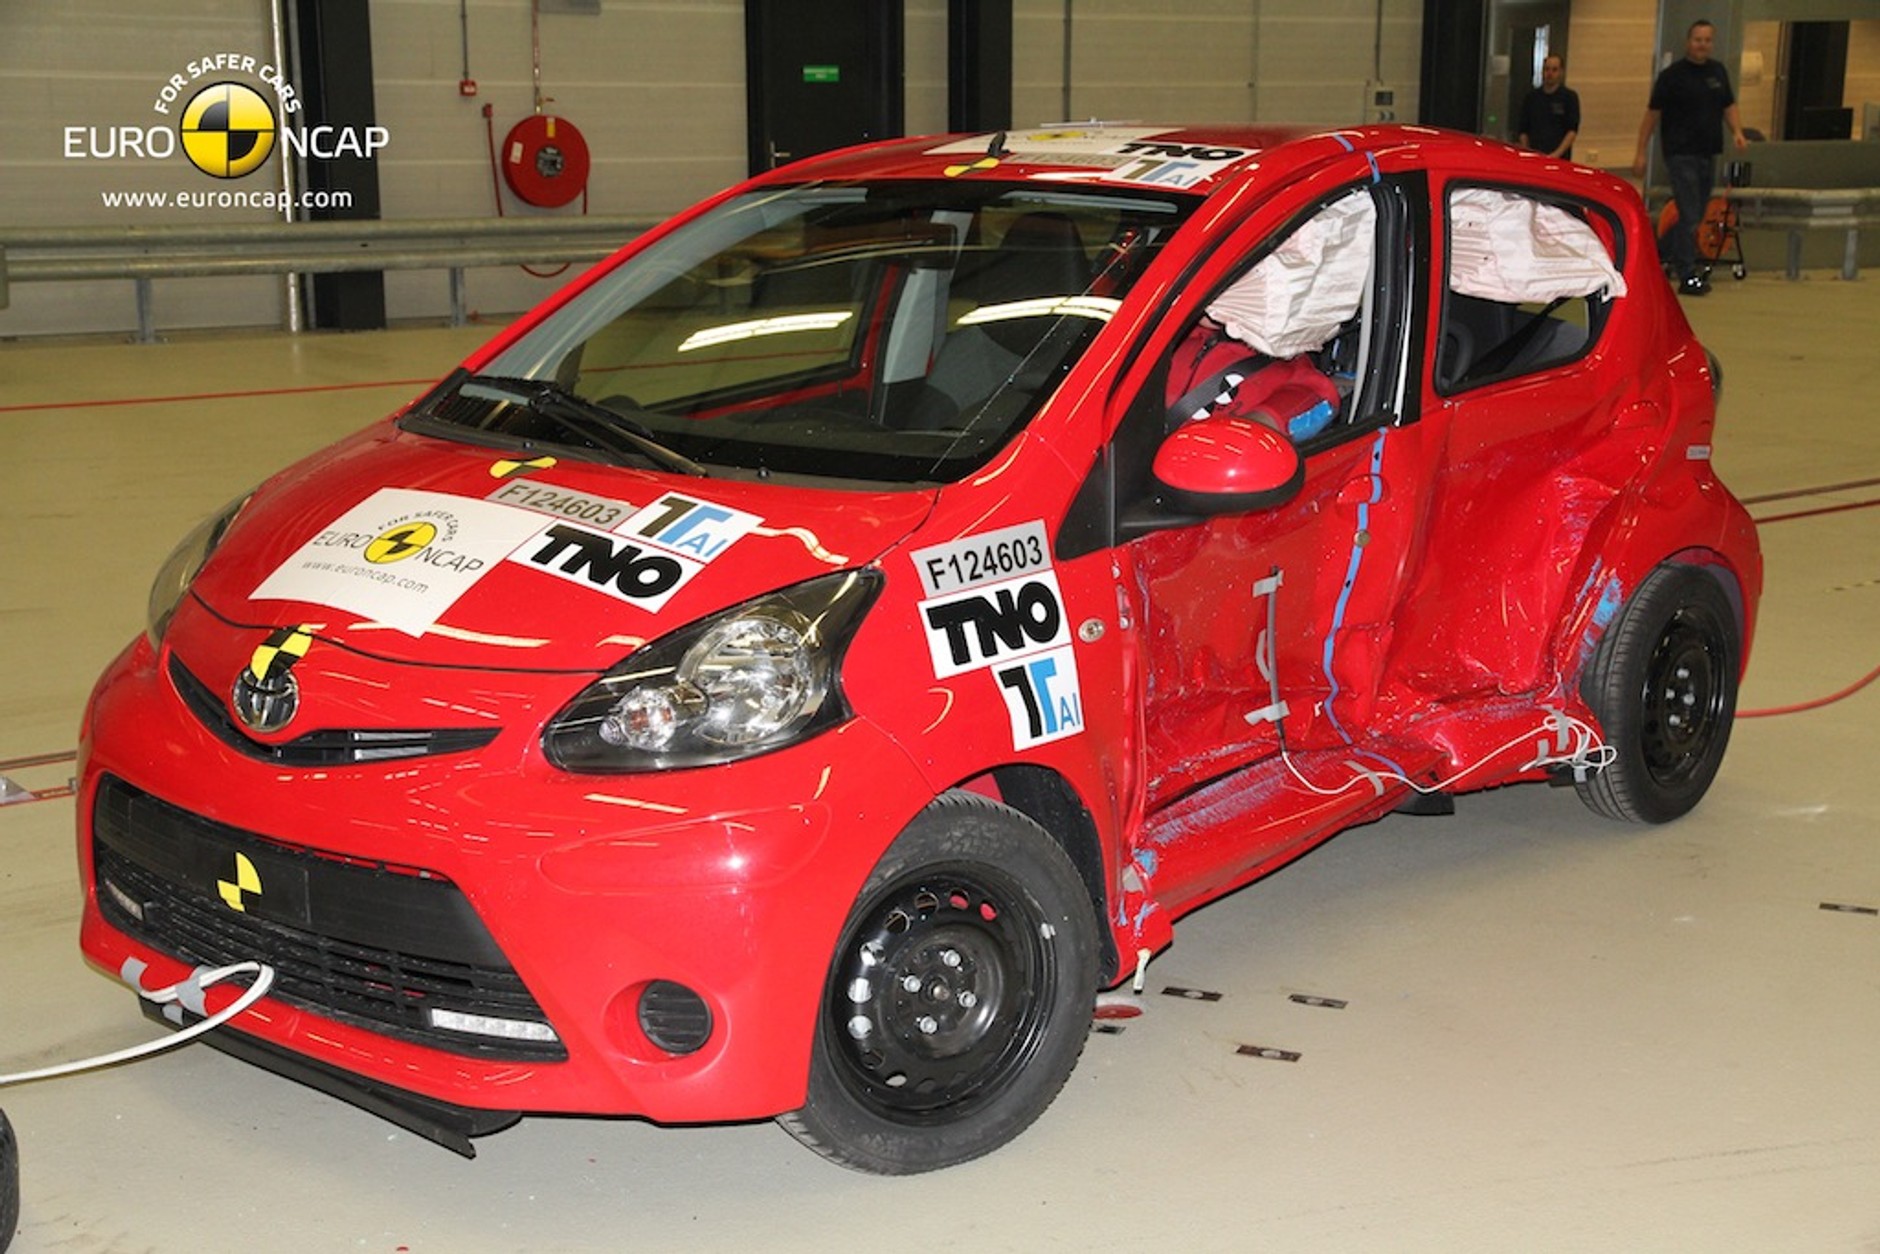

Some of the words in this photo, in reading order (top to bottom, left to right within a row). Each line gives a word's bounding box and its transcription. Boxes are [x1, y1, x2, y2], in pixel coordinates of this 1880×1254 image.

[1117, 143, 1245, 160] TNO
[498, 483, 621, 525] F124603
[313, 531, 374, 550] EURO
[415, 546, 485, 574] NCAP
[530, 523, 683, 598] TNO
[926, 535, 1043, 590] F124603
[302, 560, 430, 595] www.euroncap.com
[926, 581, 1061, 666] TNO
